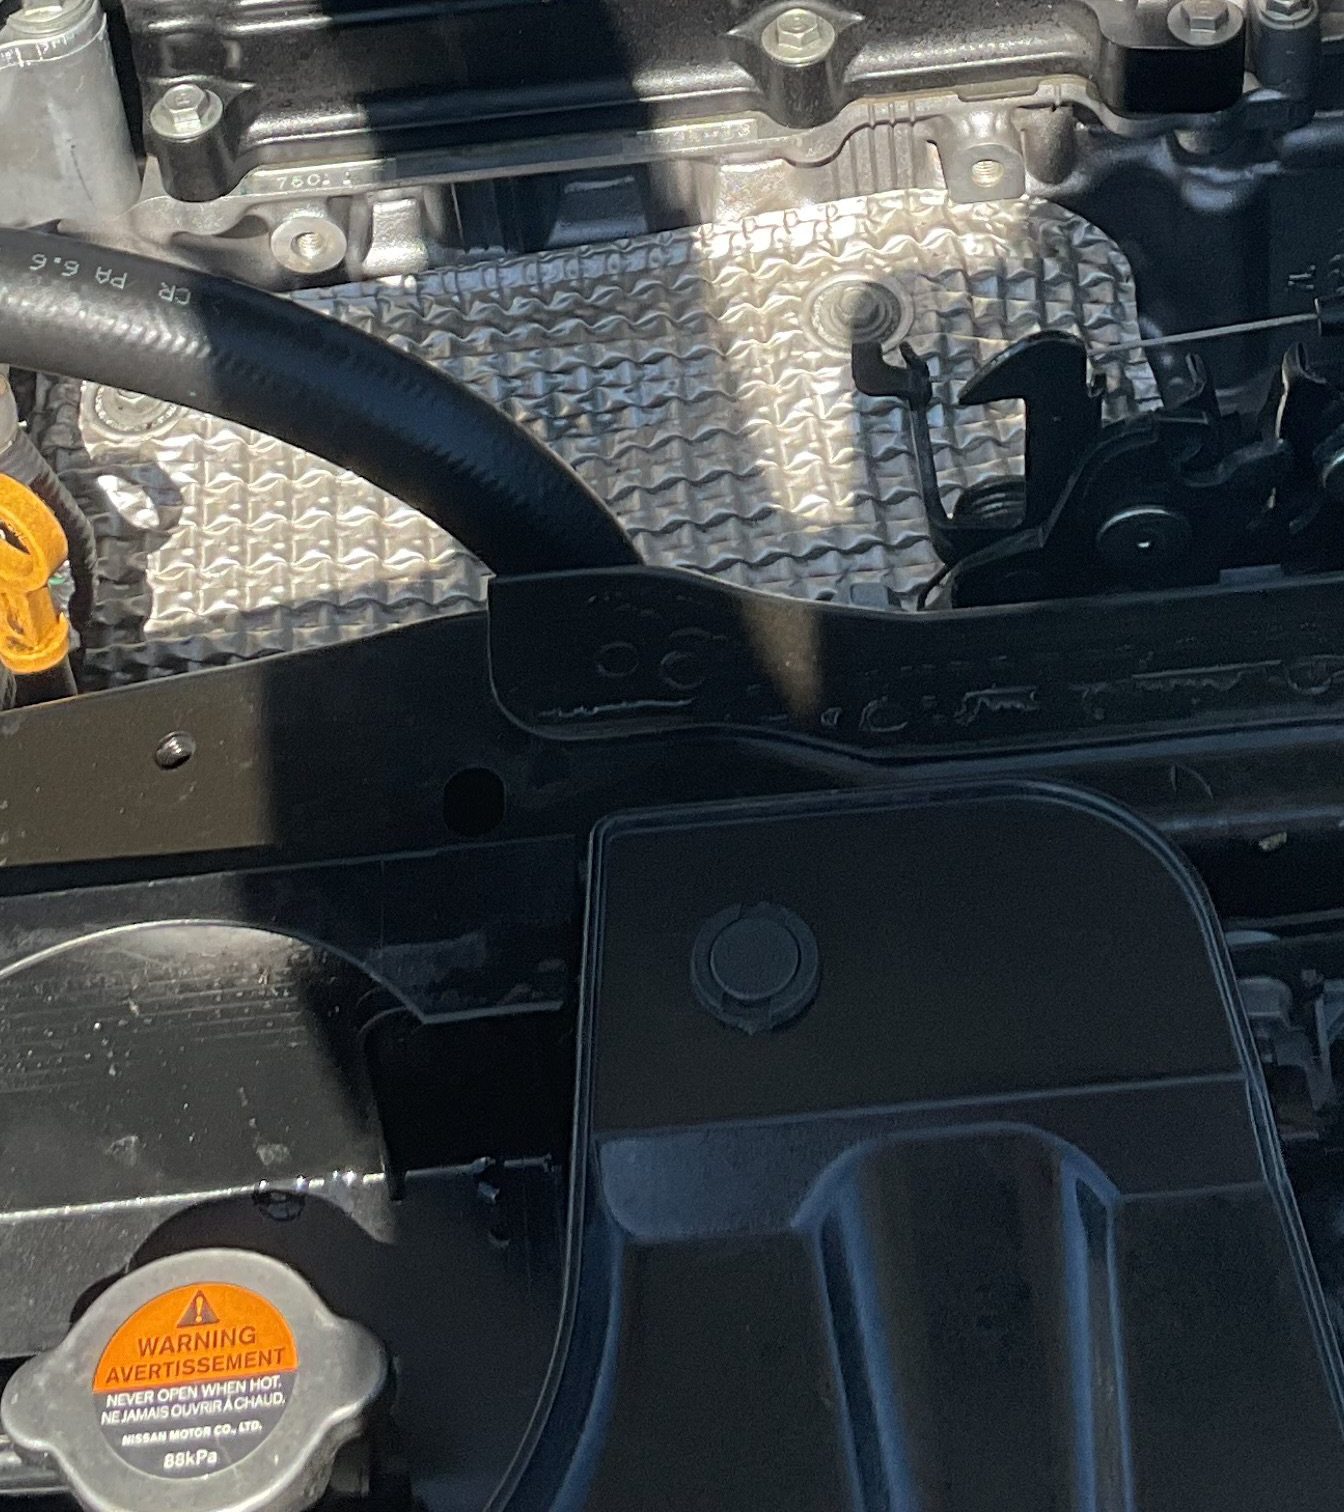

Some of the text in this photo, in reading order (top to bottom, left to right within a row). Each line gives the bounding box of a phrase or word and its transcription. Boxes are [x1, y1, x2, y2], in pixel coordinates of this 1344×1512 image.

[31, 254, 78, 278] 6.6
[95, 265, 129, 291] PA
[157, 279, 193, 305] CR
[138, 1327, 256, 1356] WARNING
[106, 1346, 286, 1384] AVERTISSEMENT
[107, 1375, 281, 1407] NEVER OPEN WHEN HOT.
[101, 1408, 120, 1425] NE
[121, 1404, 169, 1423] JAMAIS
[171, 1398, 222, 1418] OUVRIR
[235, 1392, 286, 1410] CHAUD.
[122, 1431, 165, 1446] NISSAN
[169, 1426, 210, 1442] MOTOR
[239, 1420, 262, 1434] LTD.
[164, 1448, 217, 1469] 88kPa
